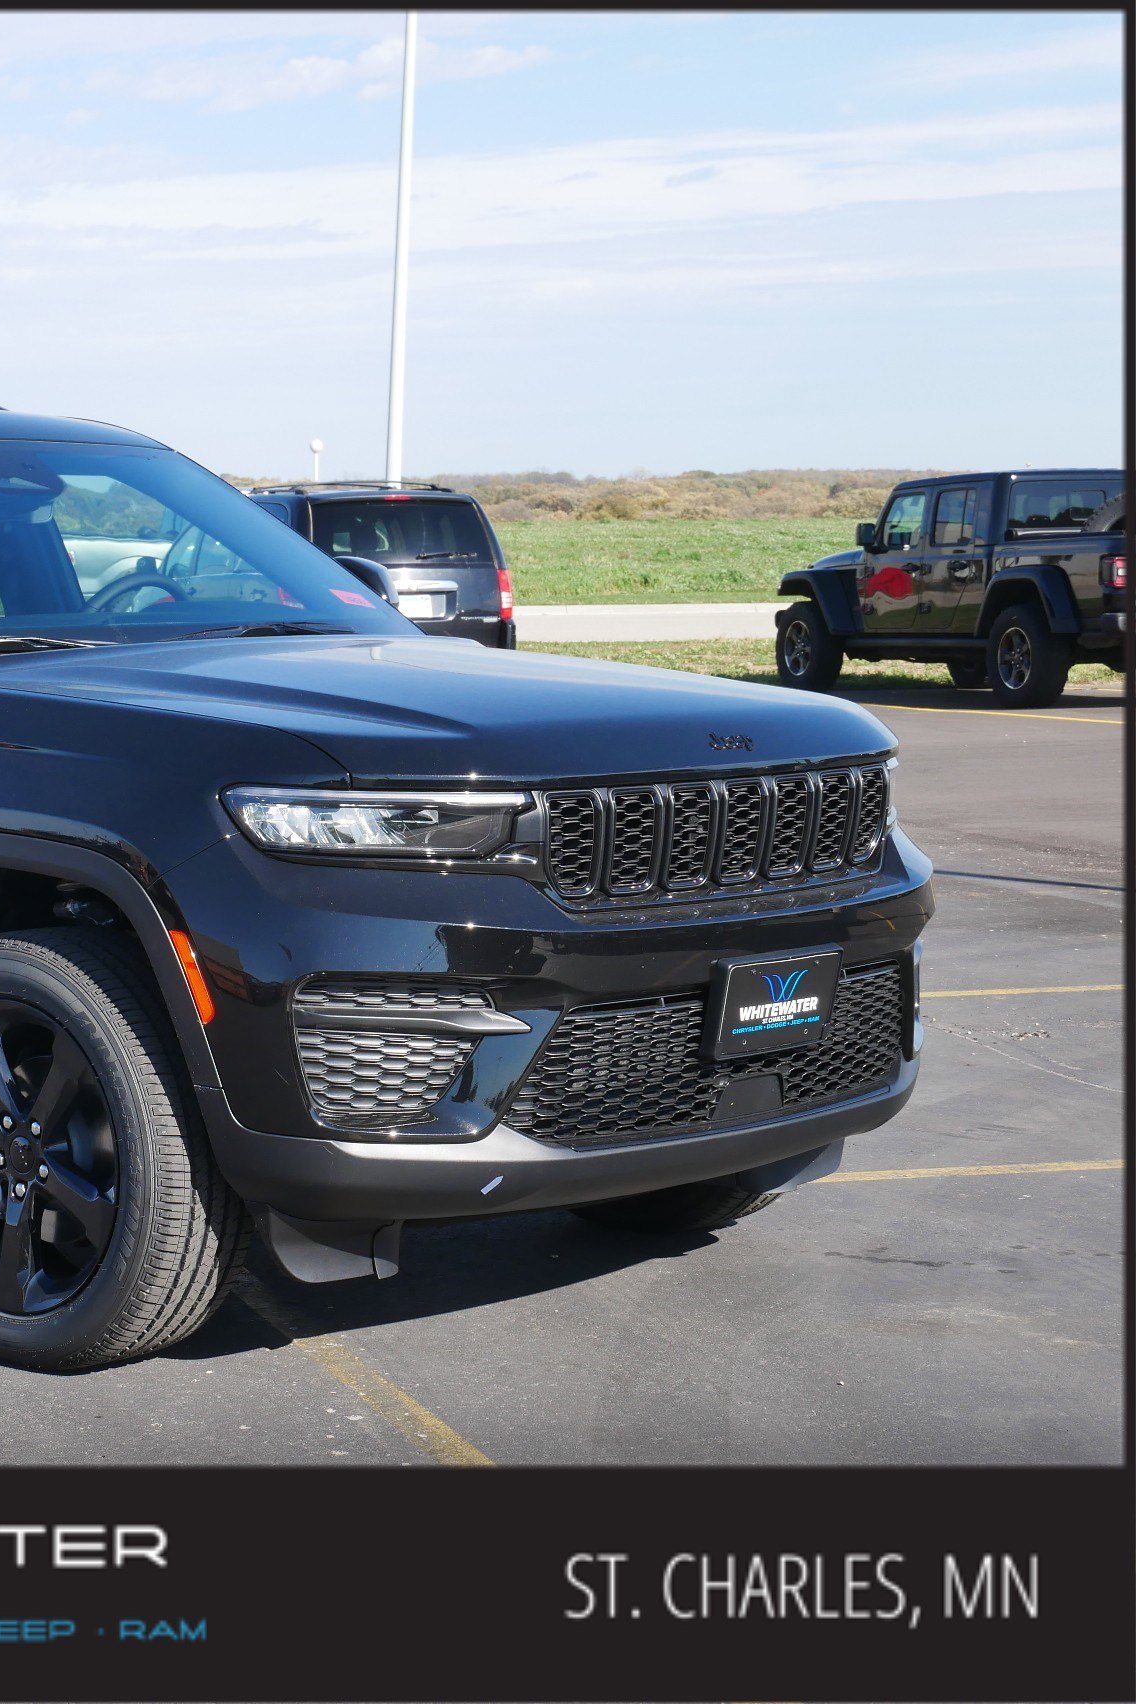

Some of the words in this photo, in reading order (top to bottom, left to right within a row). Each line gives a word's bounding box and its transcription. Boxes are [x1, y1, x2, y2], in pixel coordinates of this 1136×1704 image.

[739, 997, 818, 1021] WHITEWATER
[732, 1025, 763, 1034] CHRYSLER
[766, 1021, 787, 1029] DODGE
